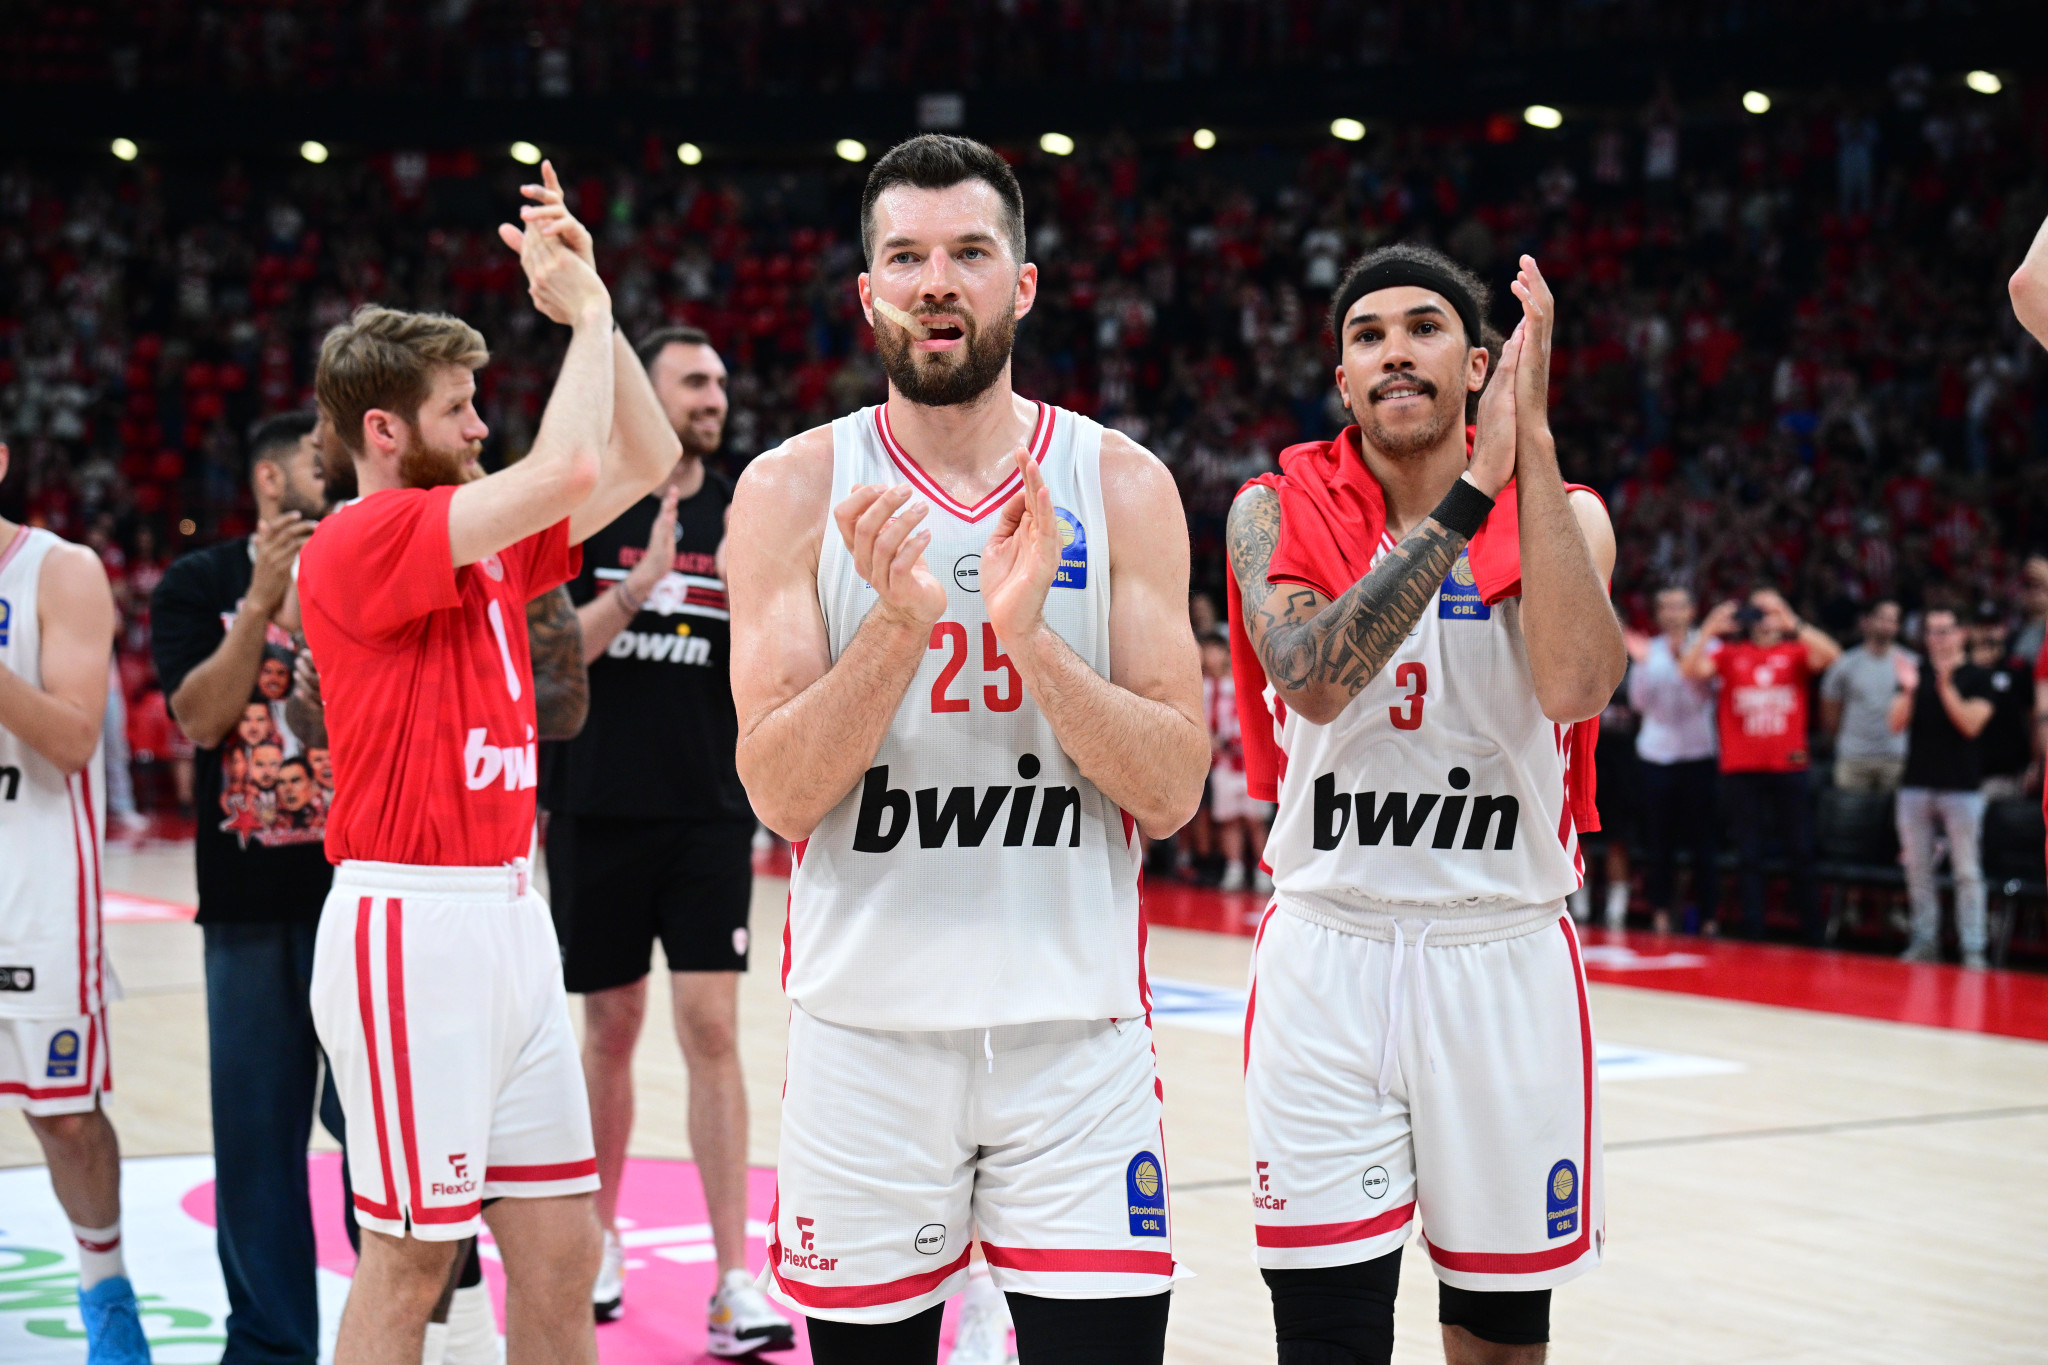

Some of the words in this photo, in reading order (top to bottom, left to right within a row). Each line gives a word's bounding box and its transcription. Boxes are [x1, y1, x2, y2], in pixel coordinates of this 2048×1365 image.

[956, 569, 979, 577] GS
[1054, 571, 1073, 582] BL
[1441, 593, 1483, 602] Stoixima
[1452, 605, 1477, 615] GBL
[928, 621, 1023, 714] 25
[1388, 661, 1428, 731] 3
[464, 723, 538, 791] bwi
[852, 753, 1081, 853] bwin
[1313, 766, 1520, 852] bwin
[1364, 1177, 1388, 1186] GSA
[1141, 1219, 1160, 1230] GBL
[1556, 1219, 1573, 1232] GBL
[783, 1247, 839, 1271] FlexCar
